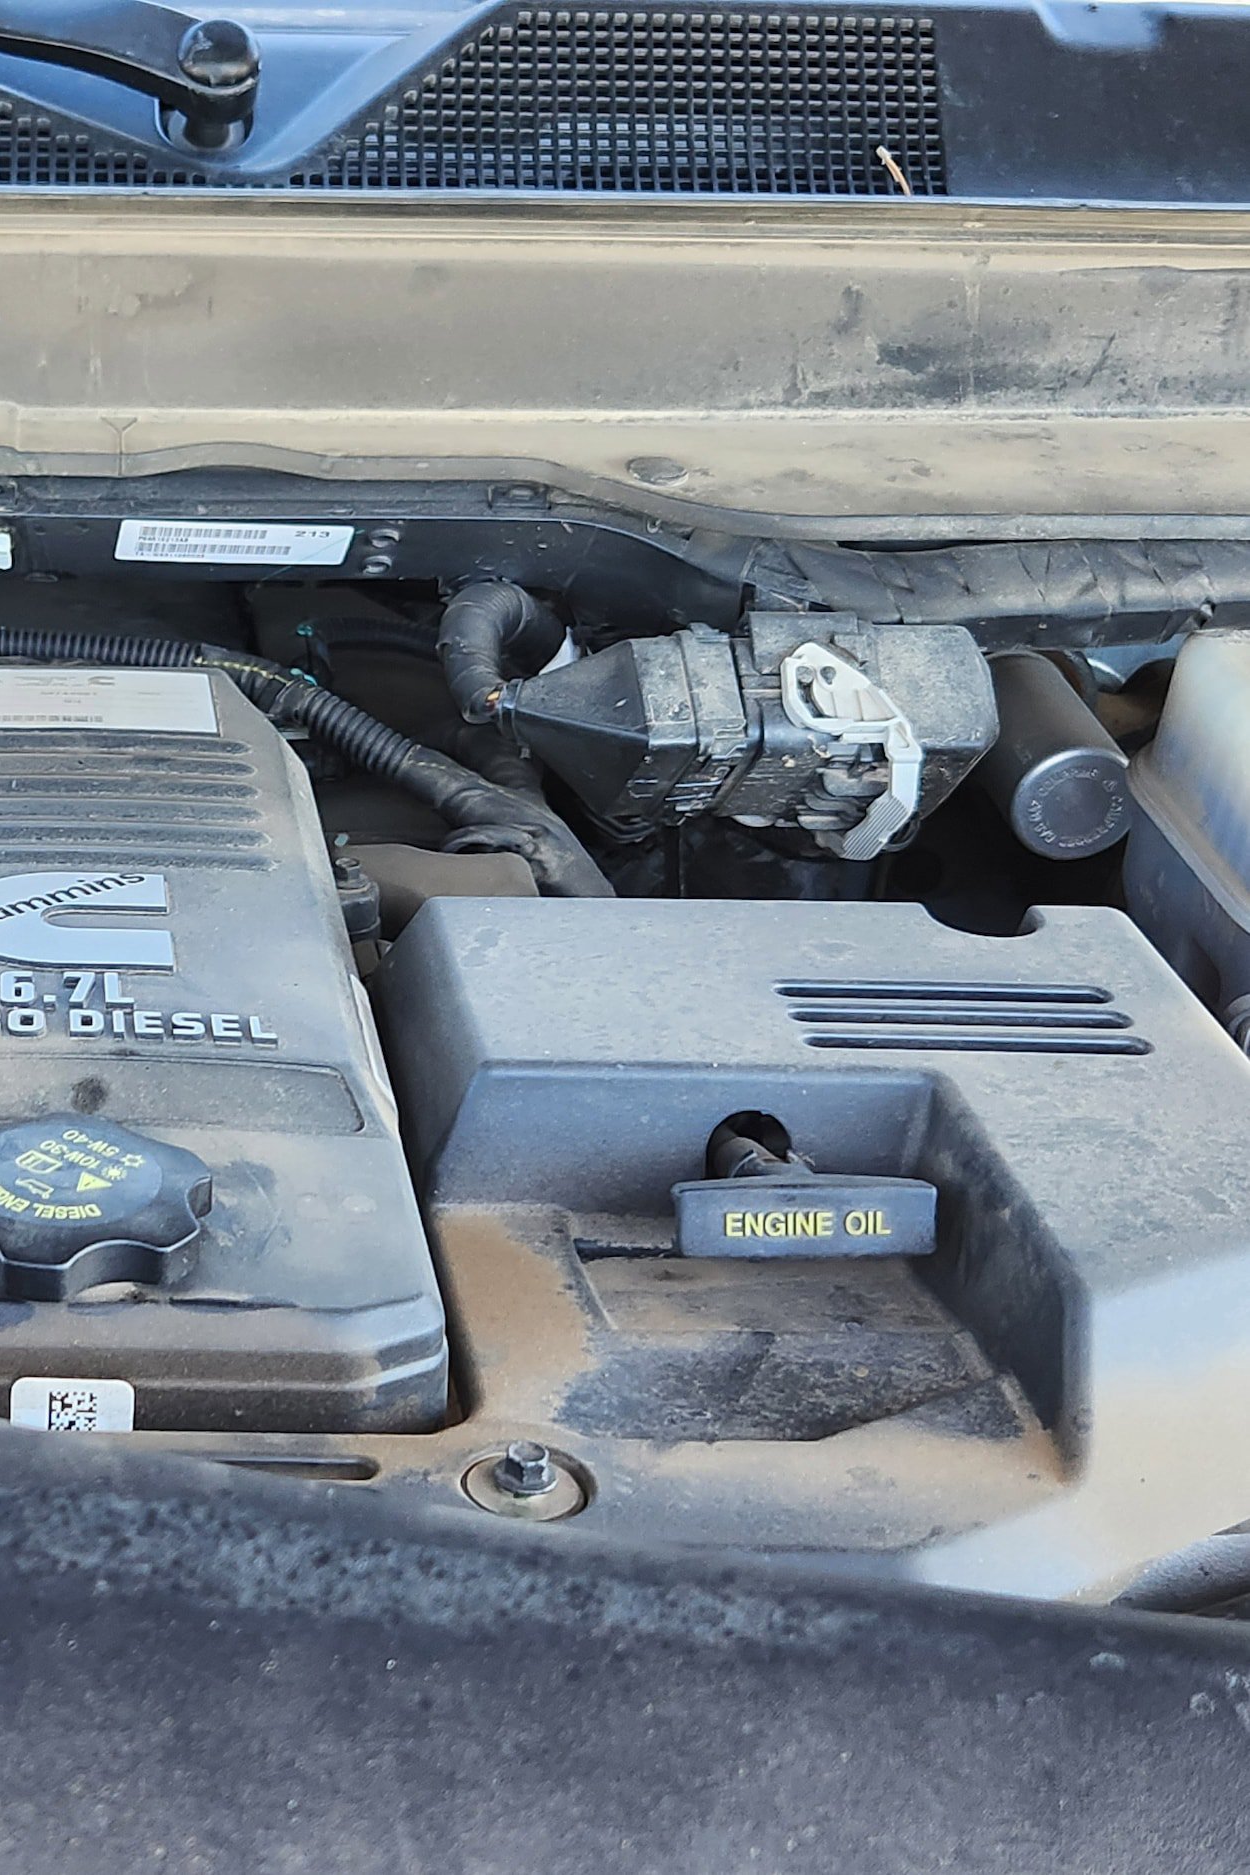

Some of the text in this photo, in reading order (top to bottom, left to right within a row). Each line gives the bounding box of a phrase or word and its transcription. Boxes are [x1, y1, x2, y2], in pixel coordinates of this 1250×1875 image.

[294, 530, 331, 538] 213
[69, 1009, 279, 1049] DIESEL
[40, 1140, 102, 1169] 10W-30
[62, 1129, 121, 1158] 5W-40
[33, 1203, 103, 1220] DIESEL
[724, 1210, 892, 1238] ENGINE OIL
